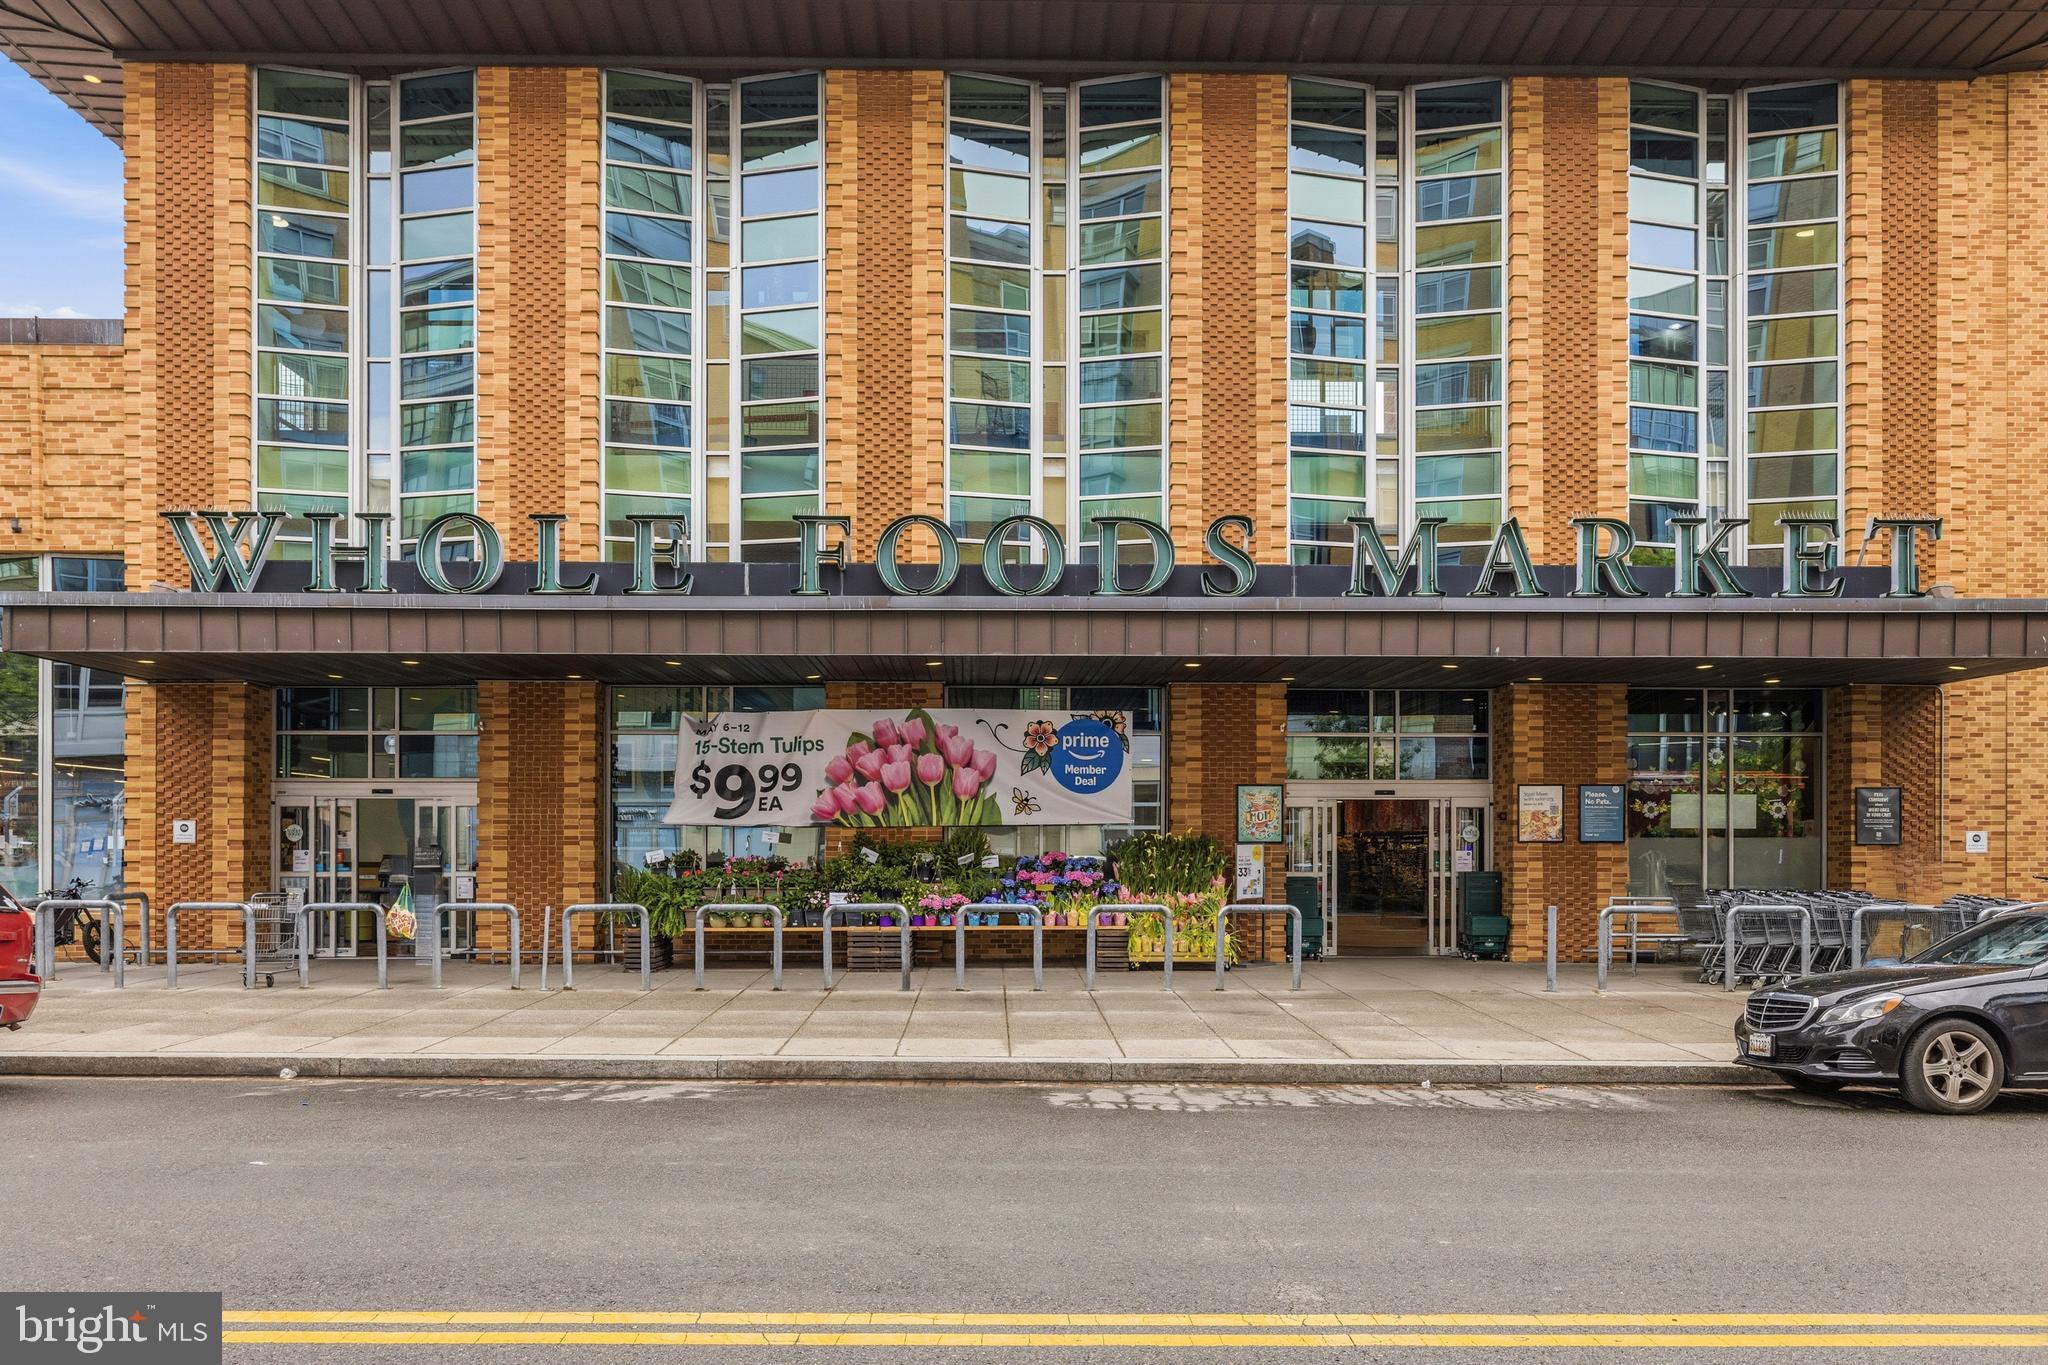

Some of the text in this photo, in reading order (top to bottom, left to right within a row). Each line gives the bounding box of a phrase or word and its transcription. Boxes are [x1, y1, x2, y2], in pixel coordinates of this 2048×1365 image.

[159, 512, 1943, 598] WHOLE FOODS MARKET
[695, 736, 824, 755] 15-Stem Tulips
[1062, 733, 1110, 750] prime
[1065, 765, 1107, 774] Member
[1075, 777, 1097, 786] Deal
[758, 796, 783, 811] EA
